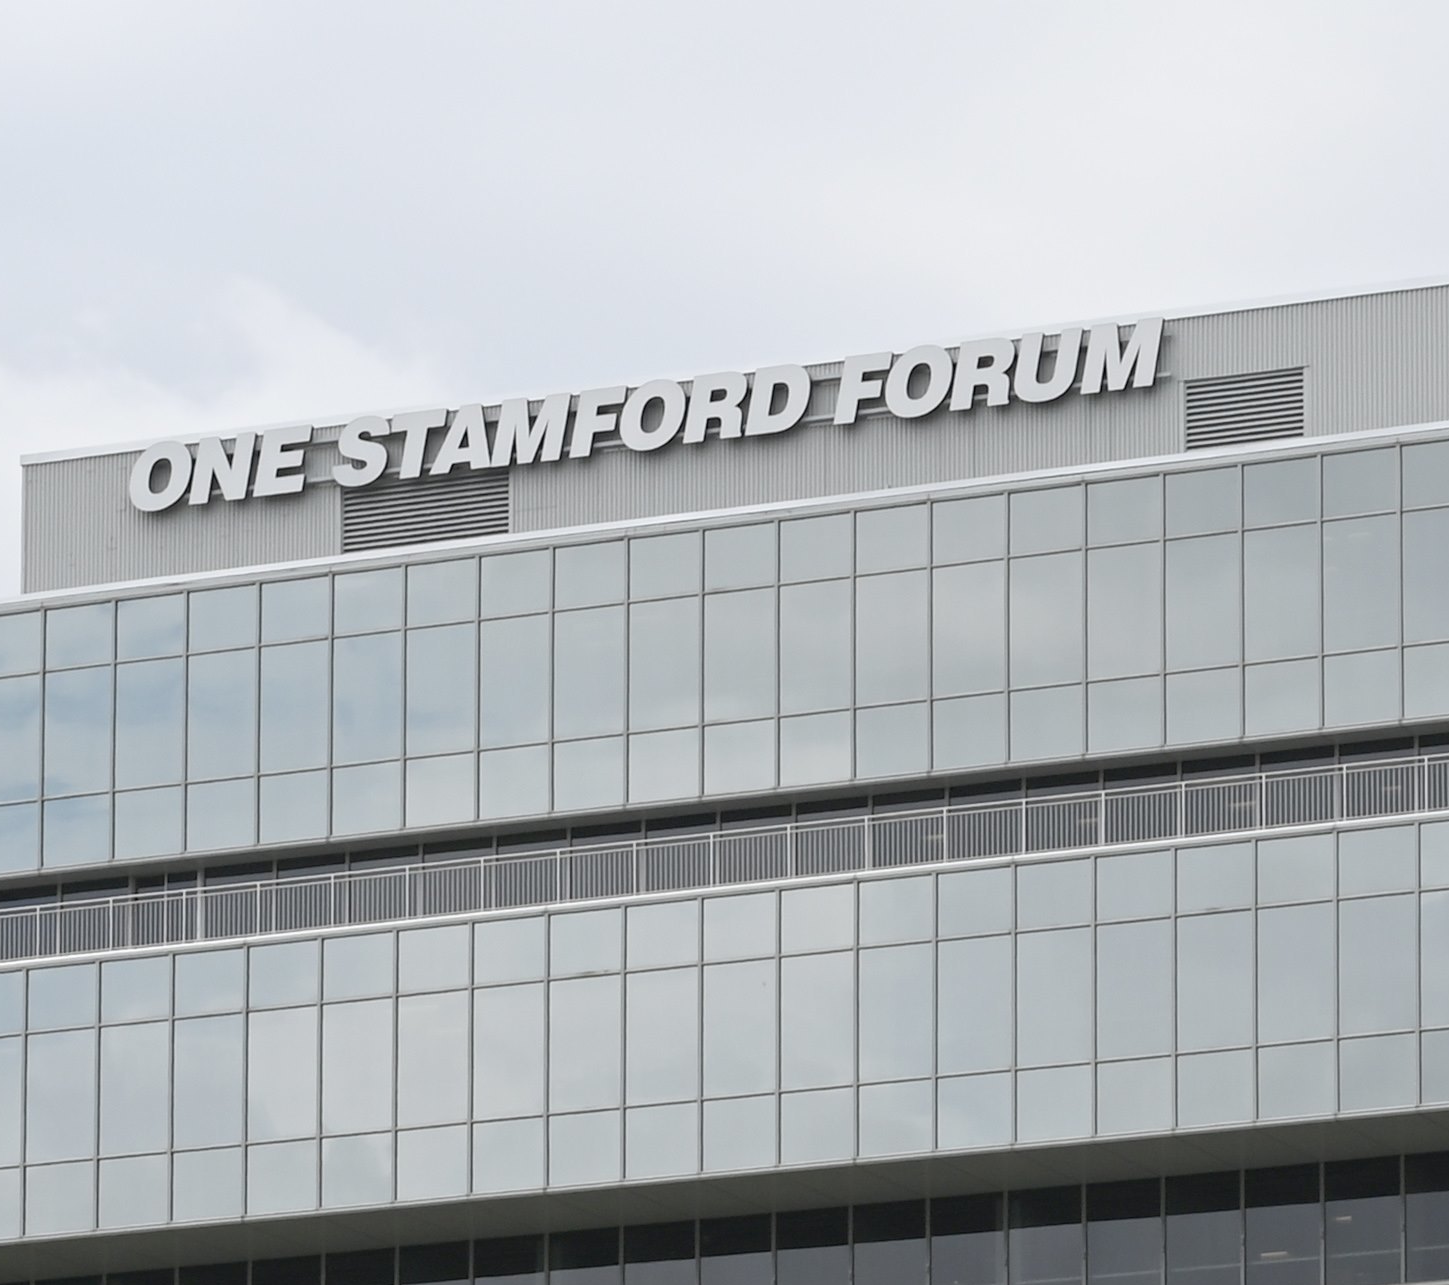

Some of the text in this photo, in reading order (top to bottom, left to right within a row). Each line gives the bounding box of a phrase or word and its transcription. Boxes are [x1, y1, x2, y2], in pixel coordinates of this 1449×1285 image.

[129, 318, 1164, 512] ONE STAMFORD FORUM
